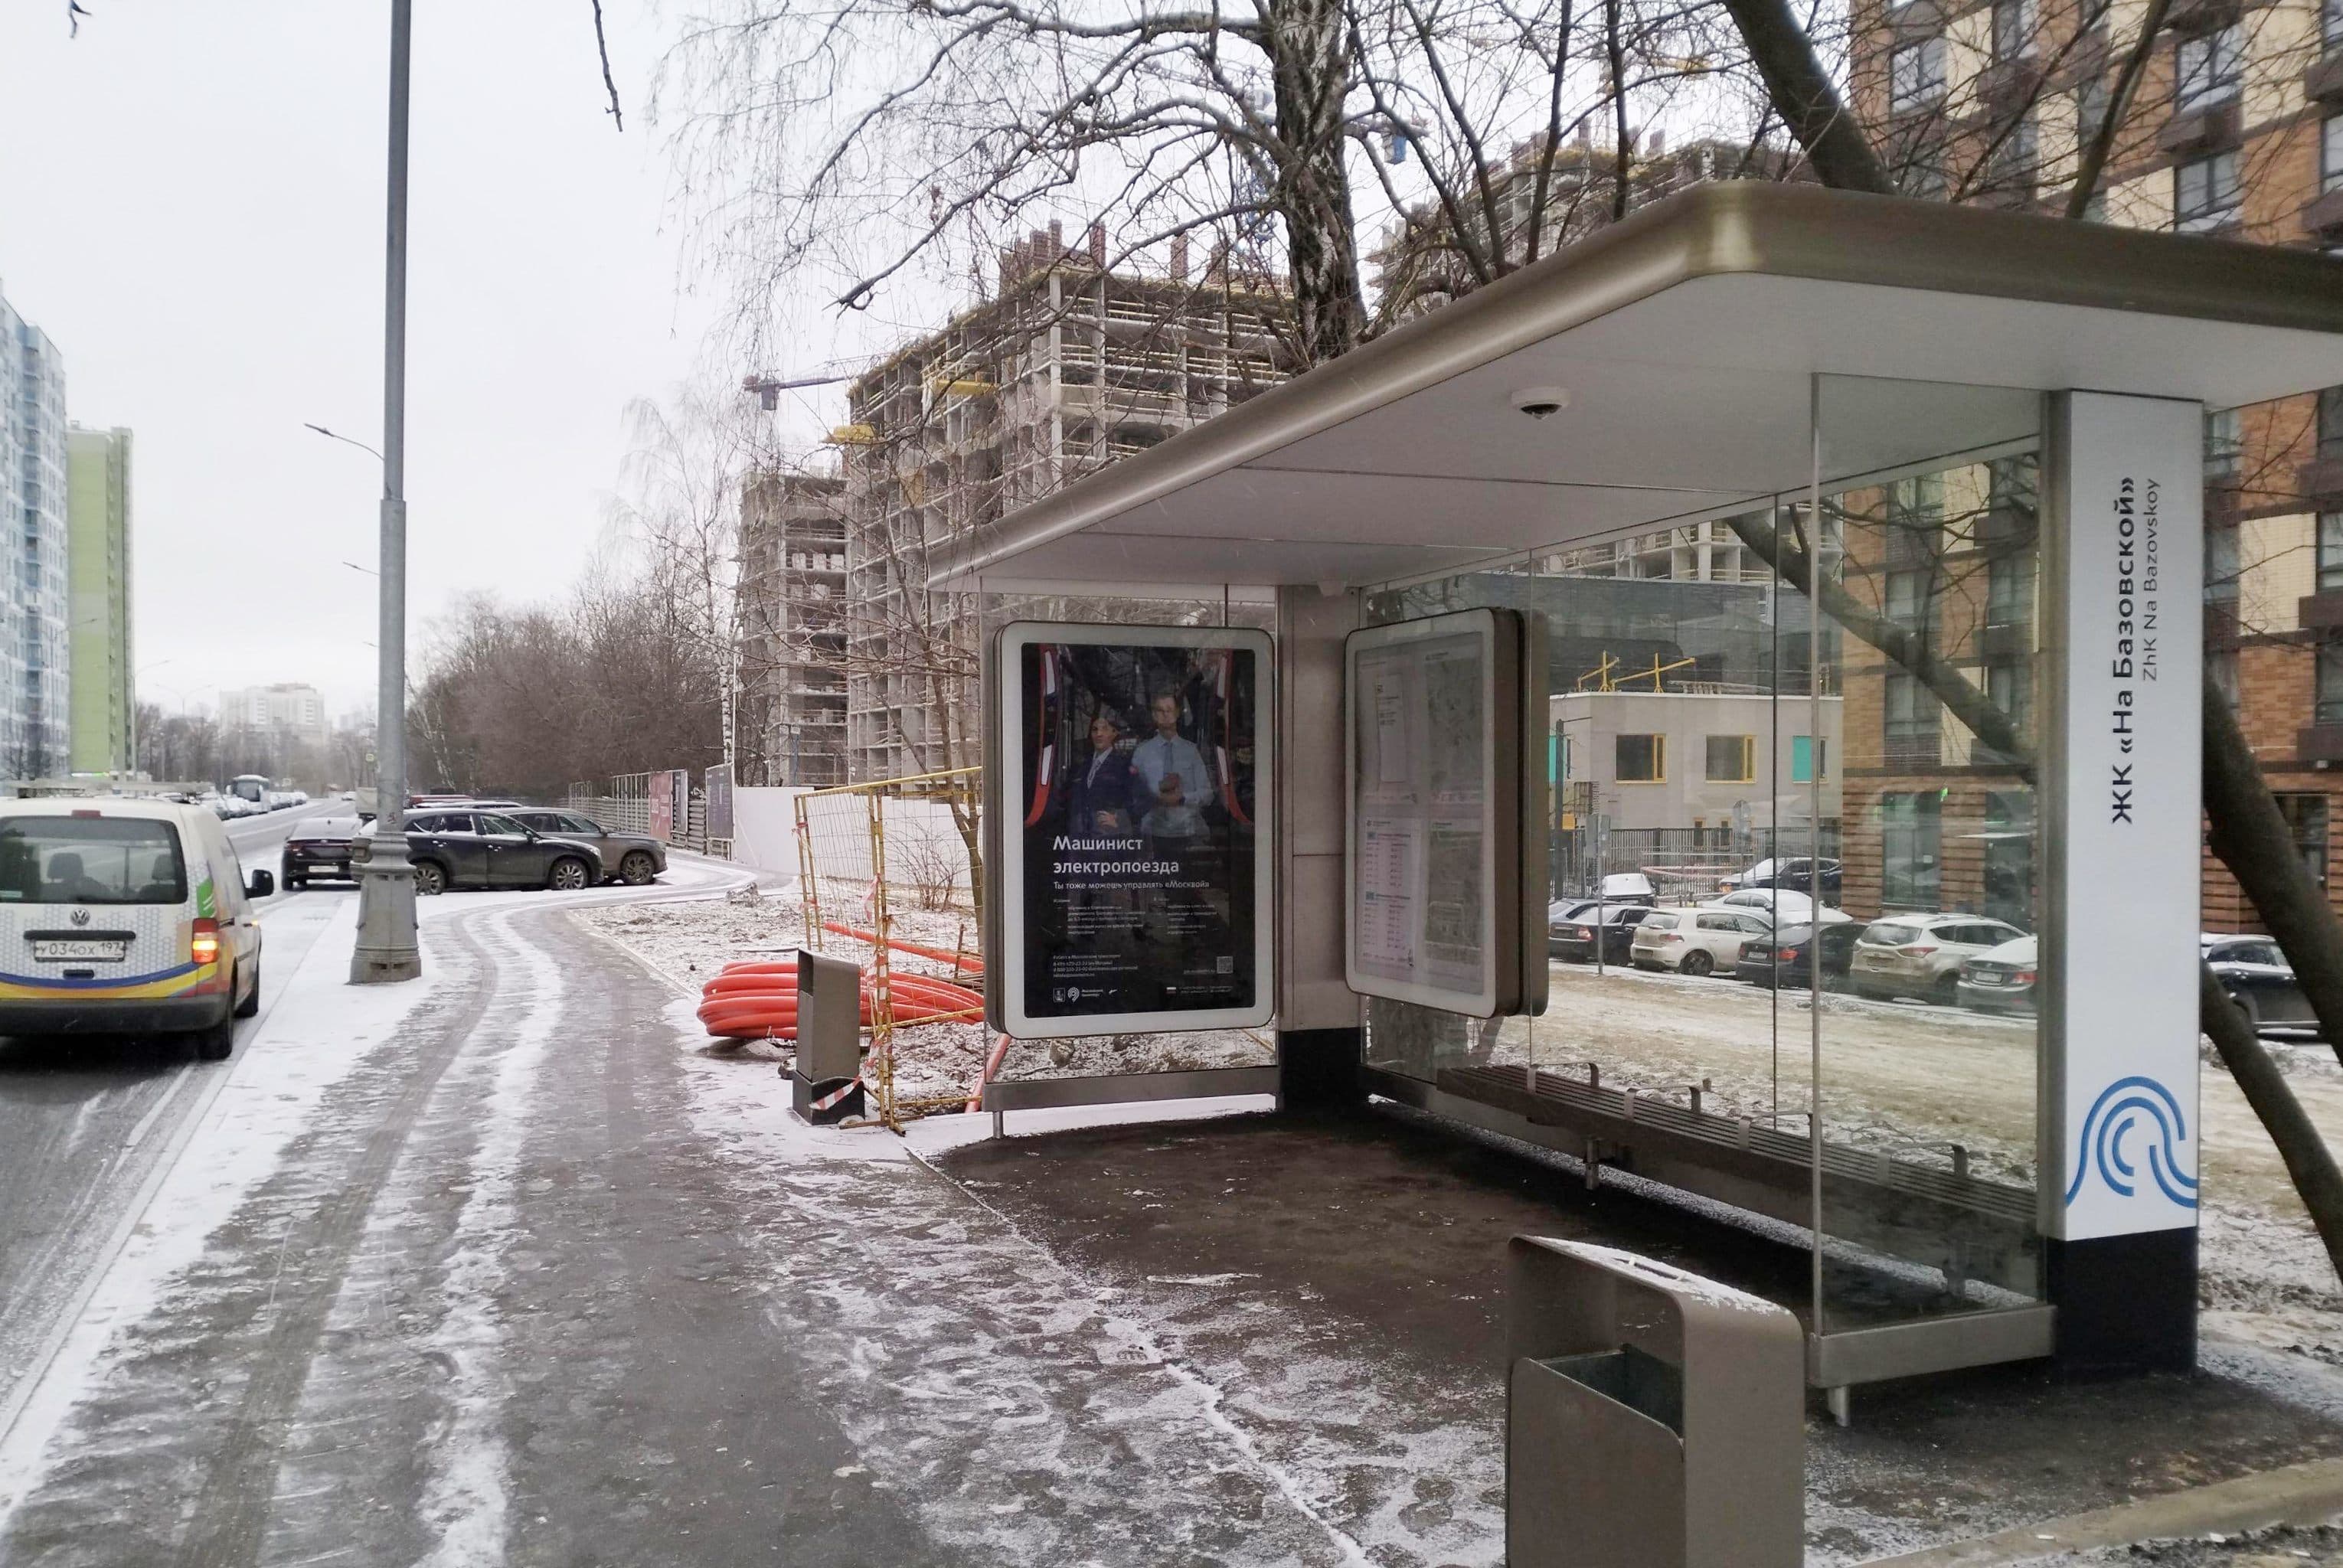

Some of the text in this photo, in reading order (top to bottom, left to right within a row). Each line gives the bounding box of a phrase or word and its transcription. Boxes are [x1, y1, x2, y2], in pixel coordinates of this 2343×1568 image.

[2142, 477, 2161, 681] ZhK Na Bazovskoy
[2113, 476, 2135, 825] ЖК «На Базовской»
[1053, 835, 1143, 851] Машинист
[1053, 861, 1180, 877] электропоезда
[1054, 881, 1064, 890] Ты
[1066, 881, 1086, 890] тоже
[1088, 881, 1122, 890] можешь
[1123, 880, 1164, 890] управлять
